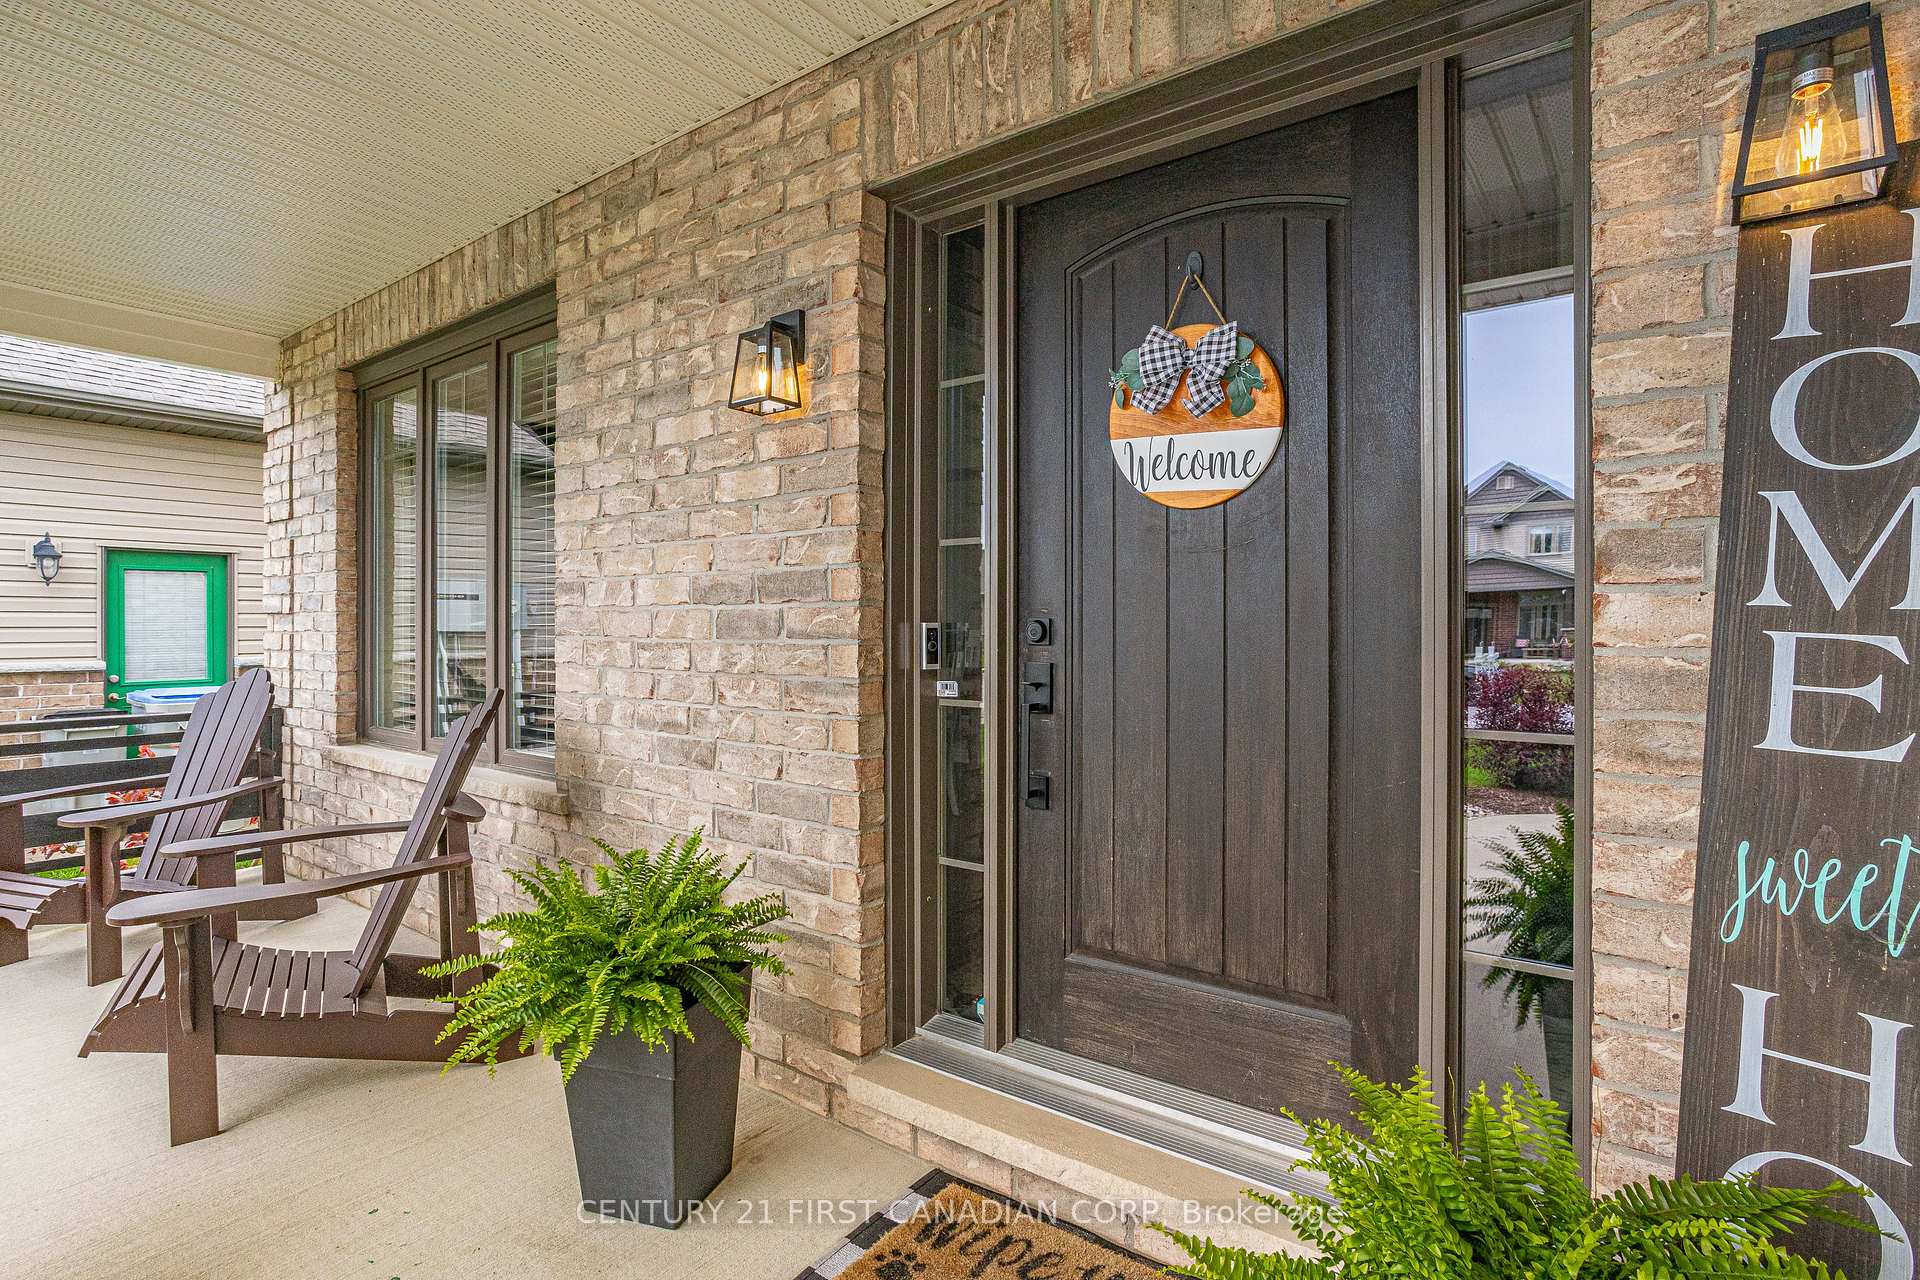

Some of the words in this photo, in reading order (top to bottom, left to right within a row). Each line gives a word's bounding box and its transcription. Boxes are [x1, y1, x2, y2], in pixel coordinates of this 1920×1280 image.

[1124, 437, 1261, 492] Welcome
[1746, 208, 1920, 763] HOME
[1720, 834, 1920, 957] sweet
